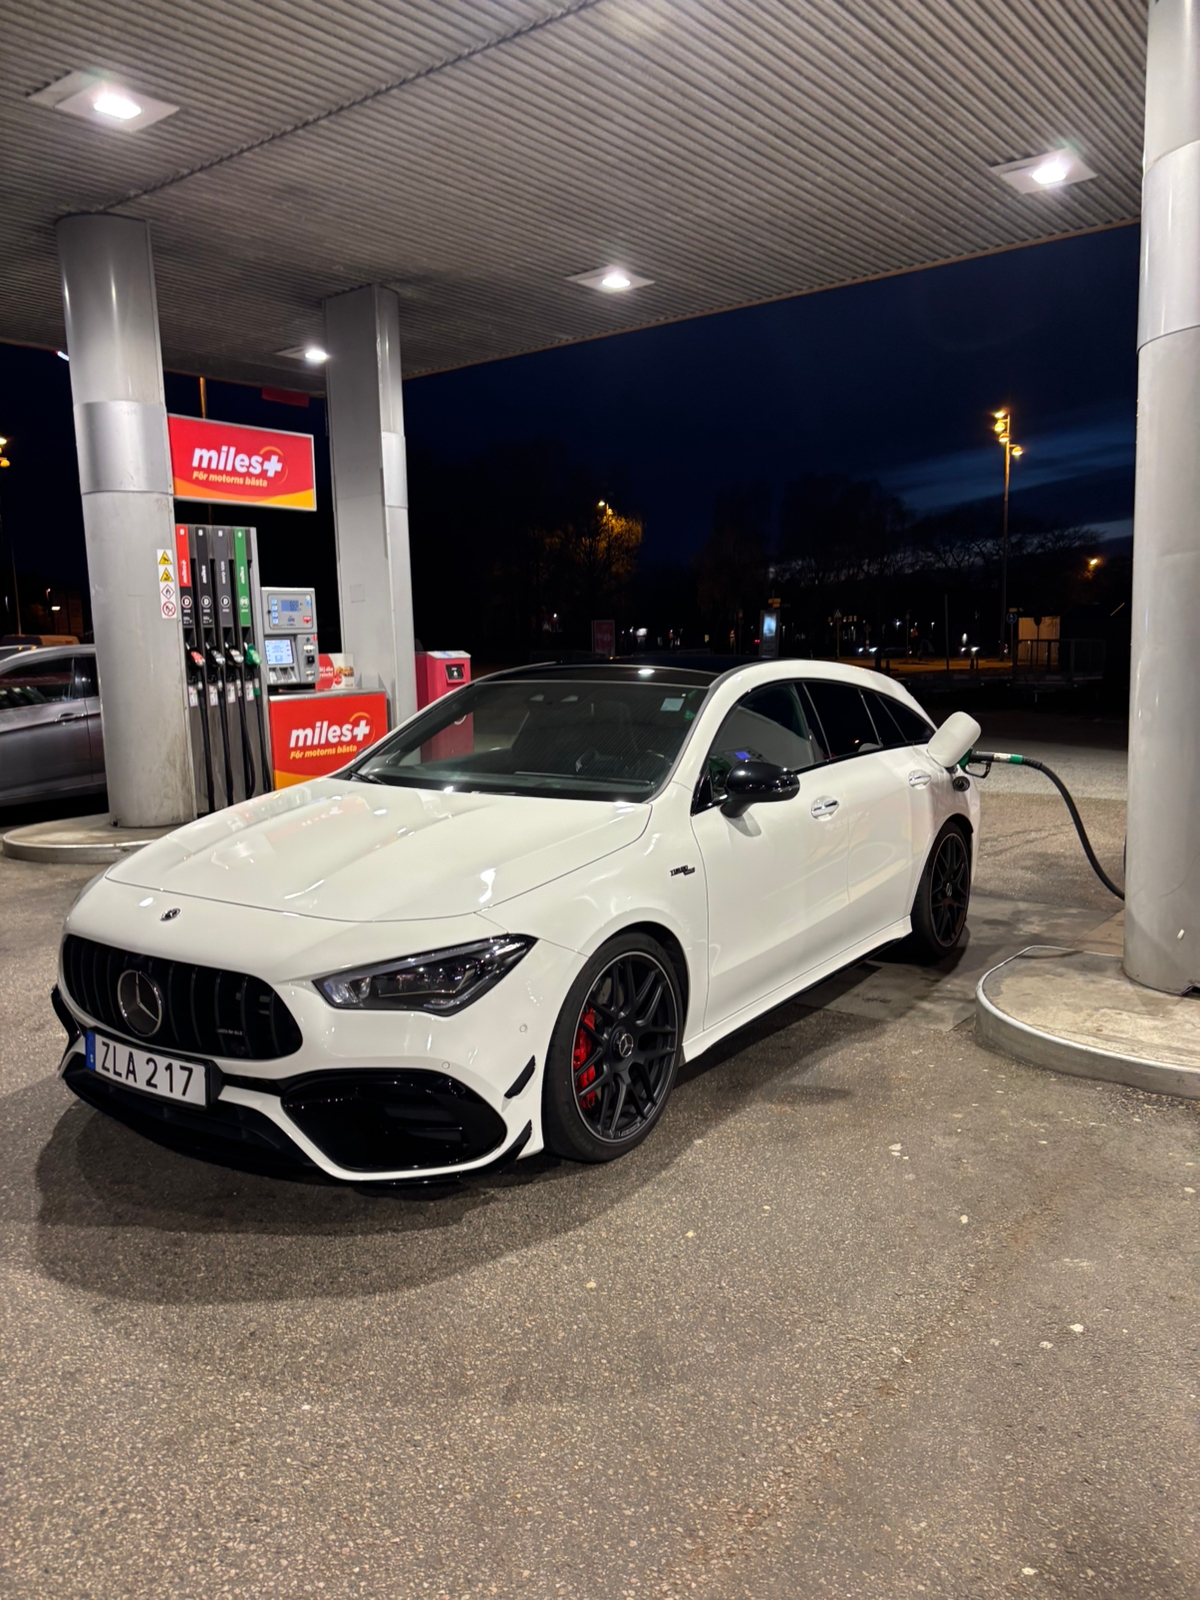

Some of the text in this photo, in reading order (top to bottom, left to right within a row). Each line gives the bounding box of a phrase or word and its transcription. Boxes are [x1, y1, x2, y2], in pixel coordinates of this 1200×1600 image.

[192, 445, 282, 478] miles+
[193, 471, 268, 488] För motorns bästa
[289, 720, 370, 748] miles+
[290, 744, 358, 760] För motorns bästa
[101, 1040, 194, 1097] ZLA 217
